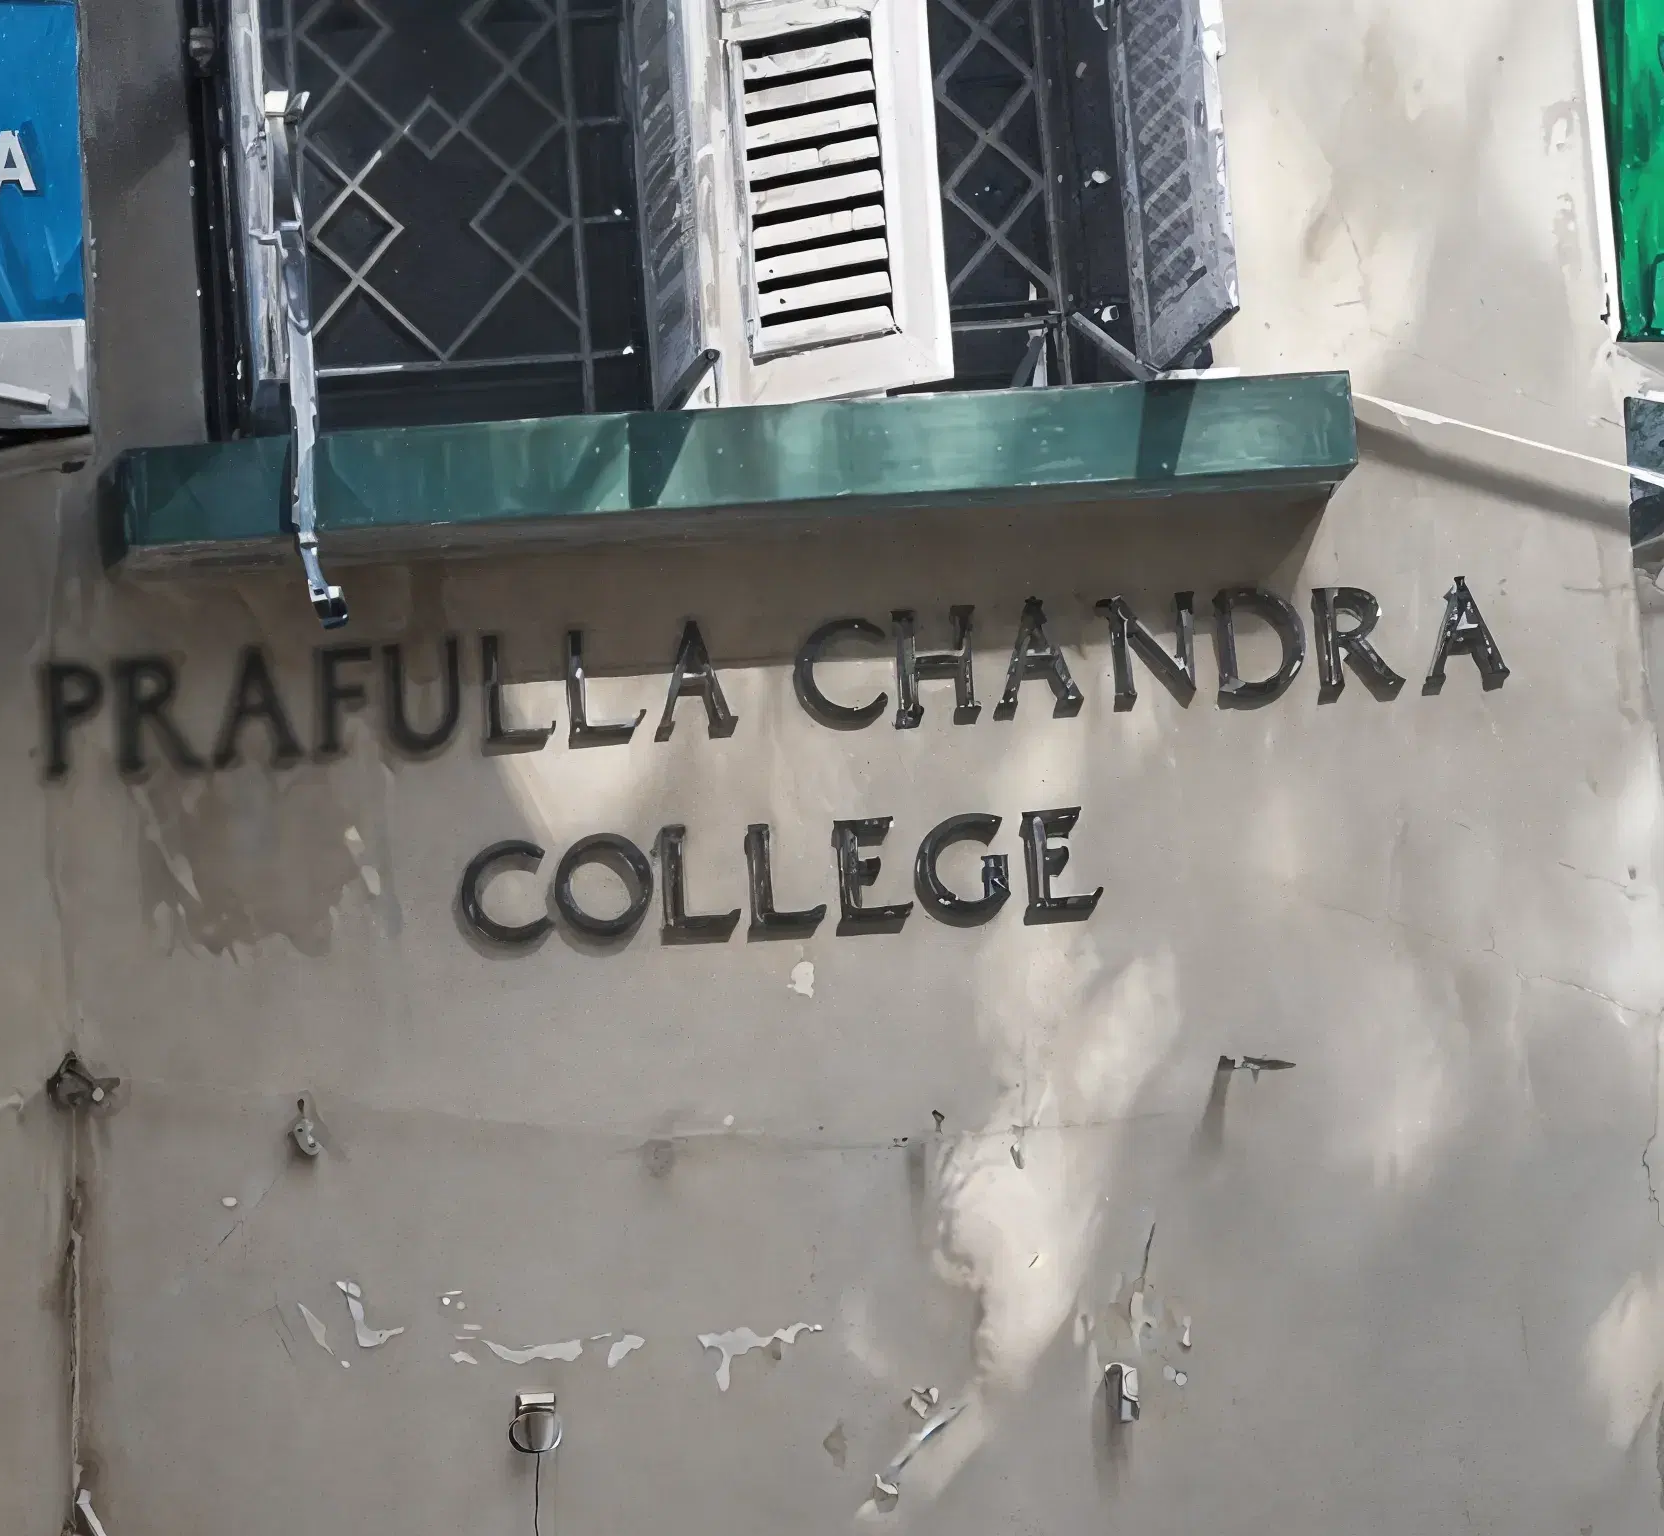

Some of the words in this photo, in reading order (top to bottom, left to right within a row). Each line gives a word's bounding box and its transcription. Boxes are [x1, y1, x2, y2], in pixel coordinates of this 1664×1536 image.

[38, 618, 742, 786] PRAFULLA
[794, 575, 1510, 732] CHANDRA
[458, 806, 1104, 948] COLLEGE
